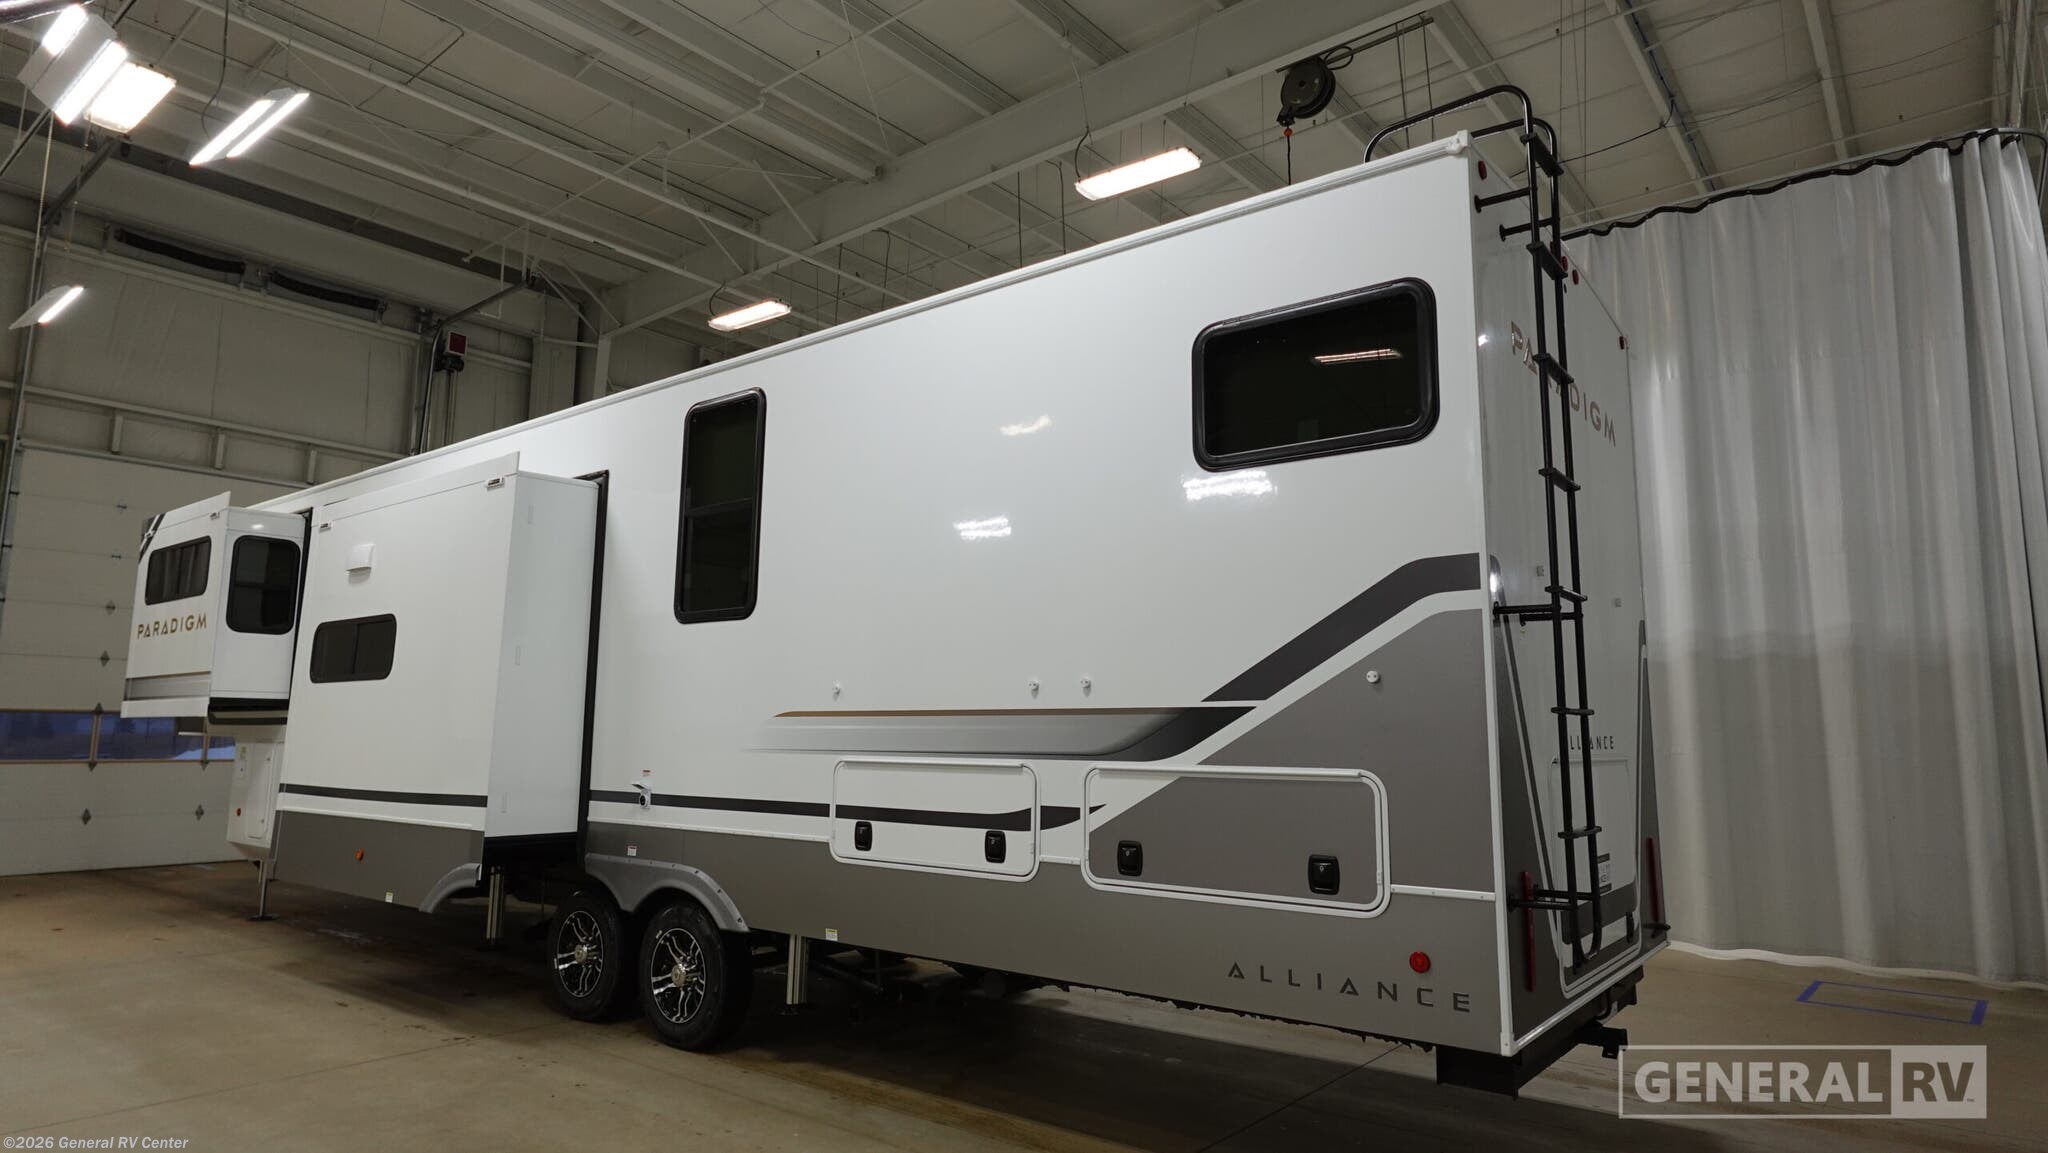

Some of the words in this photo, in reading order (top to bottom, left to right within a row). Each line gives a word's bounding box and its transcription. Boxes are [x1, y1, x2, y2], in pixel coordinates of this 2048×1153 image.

[1511, 319, 1617, 447] PADIGM
[136, 612, 207, 639] PARADIGM
[1227, 961, 1471, 1013] ALLIANCE
